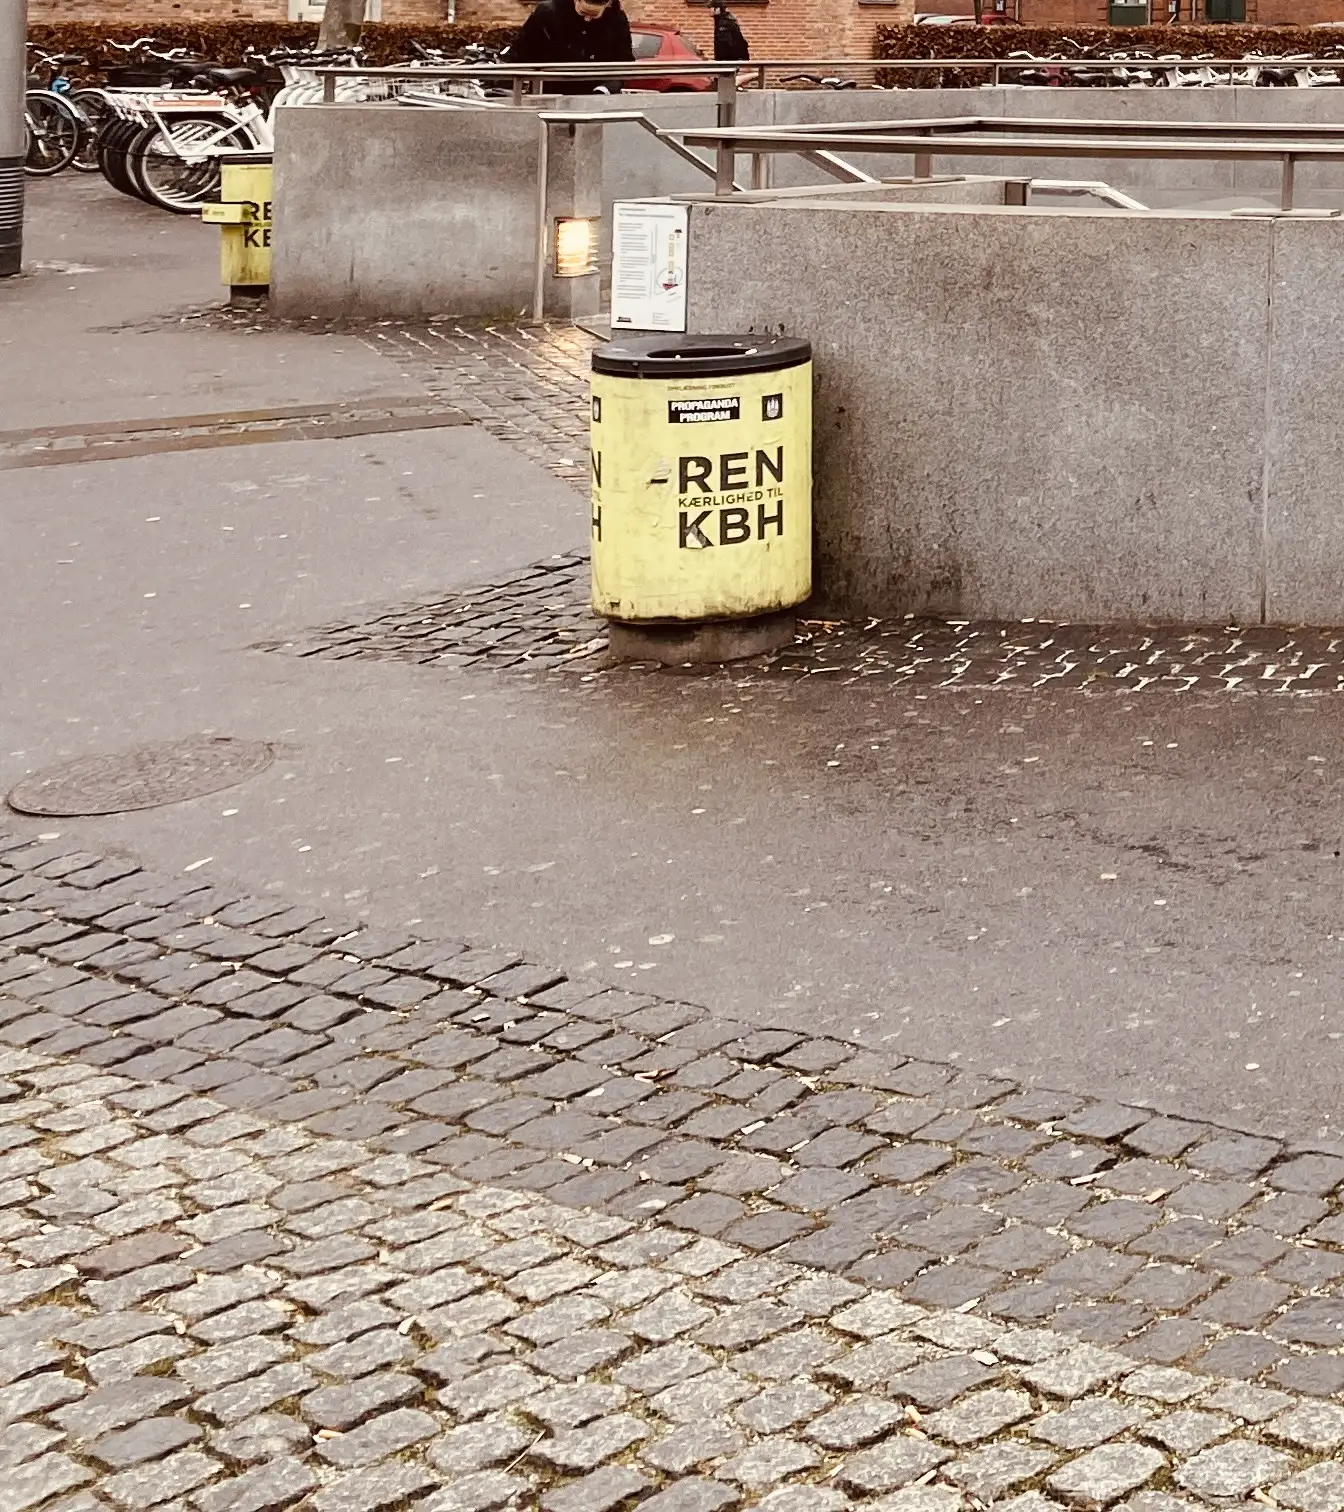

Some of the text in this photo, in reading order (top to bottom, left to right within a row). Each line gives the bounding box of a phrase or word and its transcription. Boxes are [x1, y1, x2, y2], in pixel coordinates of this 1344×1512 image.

[671, 398, 739, 411] PROPAGANDA
[680, 410, 731, 422] PROGRAM
[679, 488, 784, 508] KÆRLIGHED TIL
[679, 500, 784, 549] KBH
